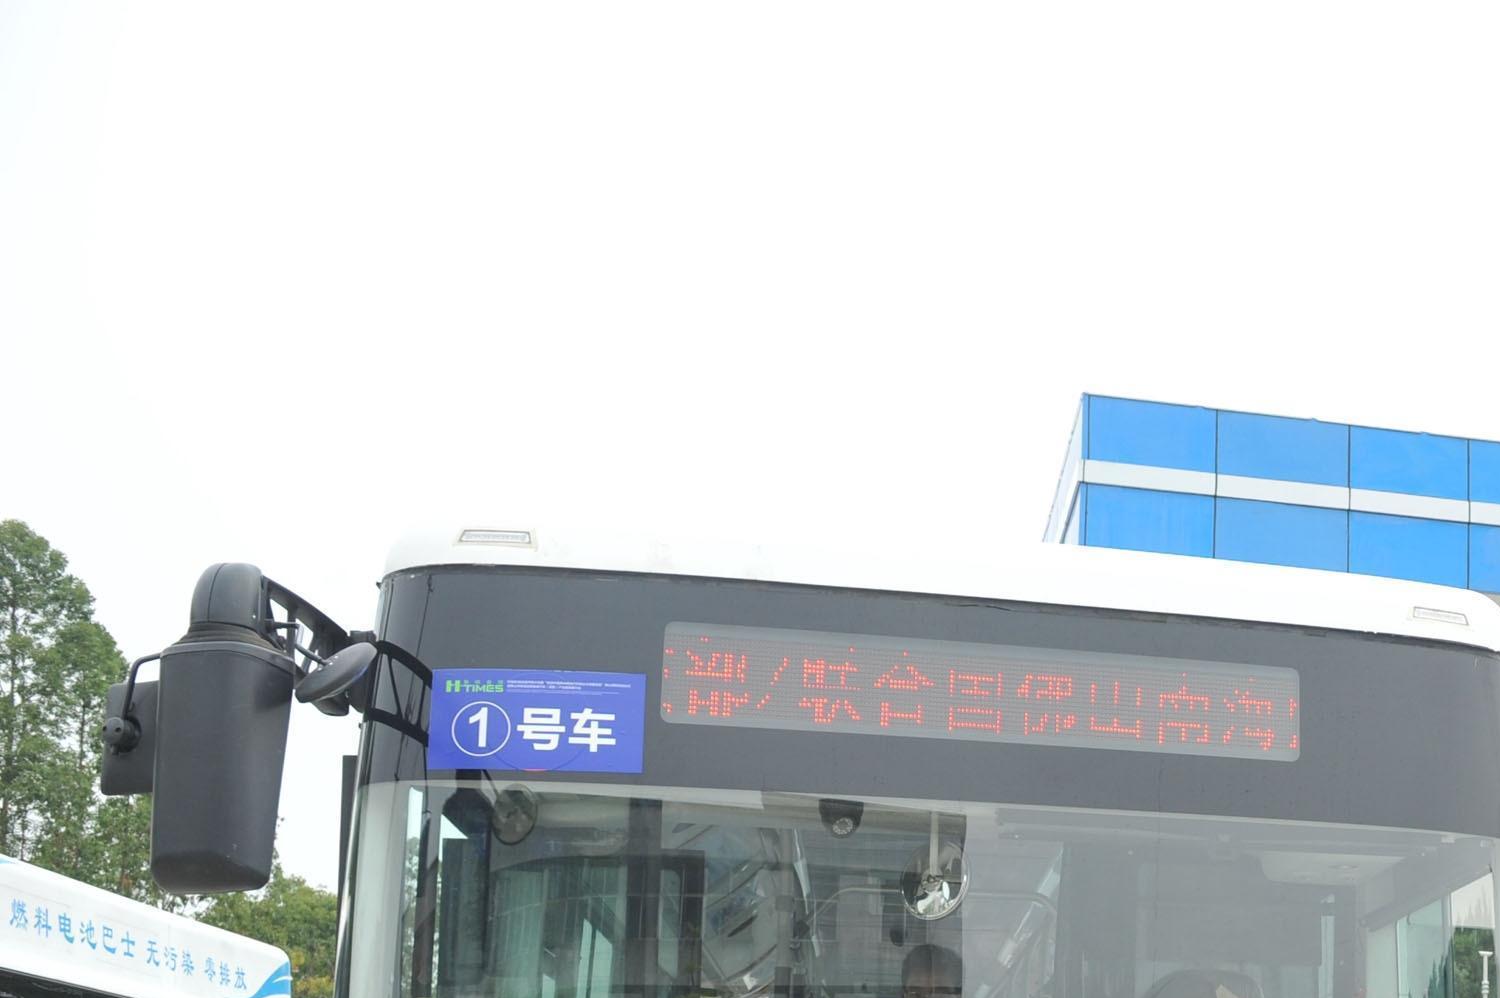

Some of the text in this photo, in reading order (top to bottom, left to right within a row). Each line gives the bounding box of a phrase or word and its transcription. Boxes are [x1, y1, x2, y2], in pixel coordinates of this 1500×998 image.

[10, 898, 248, 990] 燃料电池巴士 无污染 零排放
